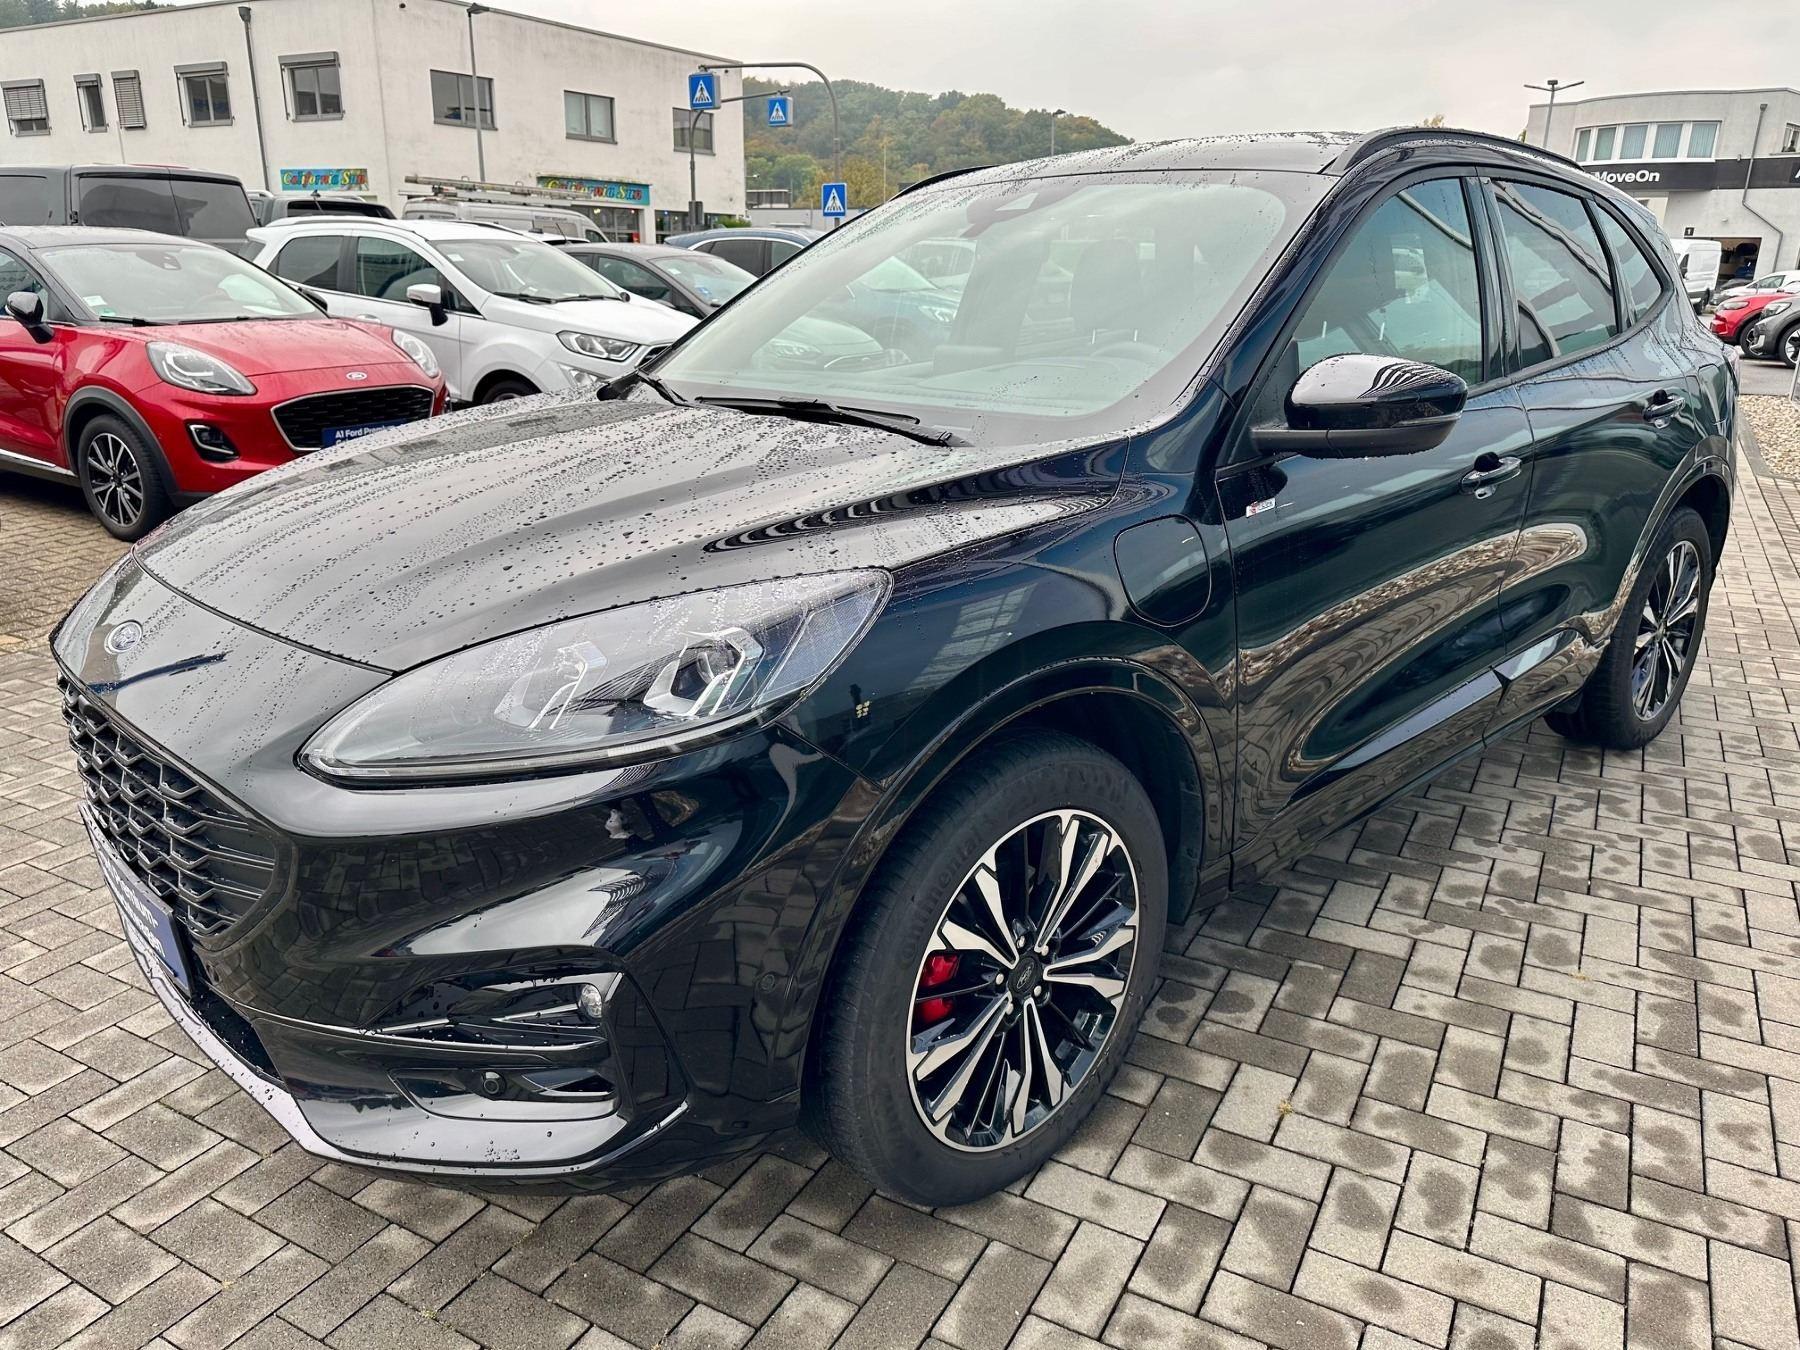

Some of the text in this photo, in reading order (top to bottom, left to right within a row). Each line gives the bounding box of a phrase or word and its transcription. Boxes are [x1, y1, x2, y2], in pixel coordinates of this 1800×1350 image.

[283, 170, 366, 188] California Sun
[617, 184, 643, 201] Sun
[335, 429, 344, 439] A1
[345, 427, 363, 438] Ford
